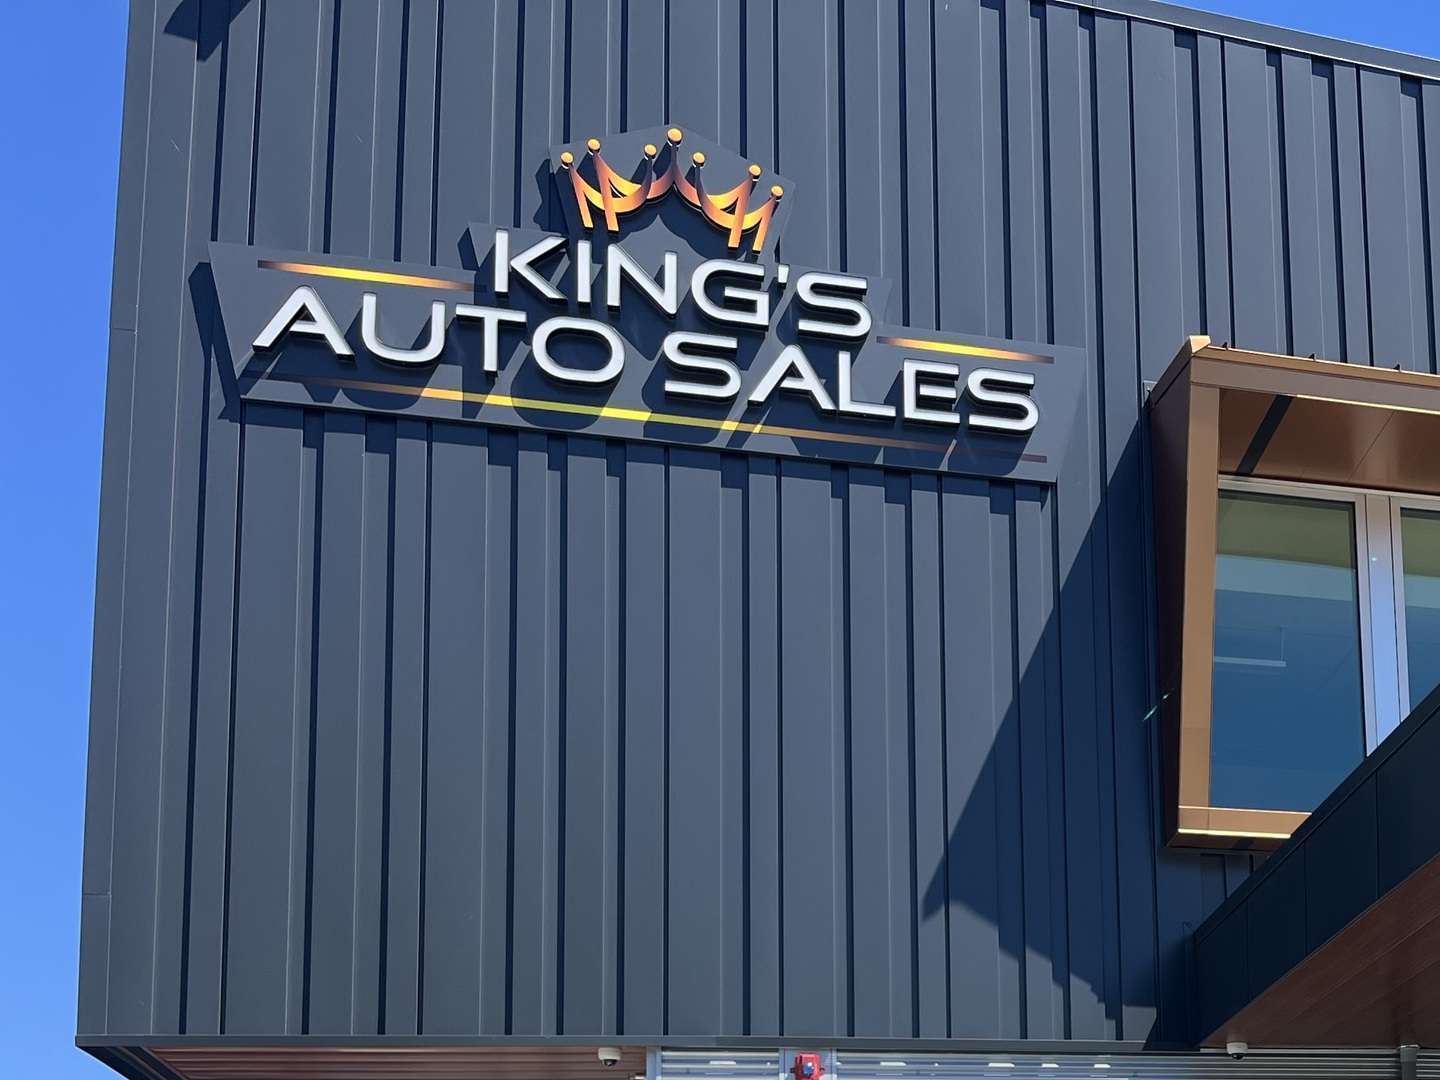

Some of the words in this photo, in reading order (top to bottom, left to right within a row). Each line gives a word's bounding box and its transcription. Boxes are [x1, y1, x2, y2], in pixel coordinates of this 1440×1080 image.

[493, 228, 873, 341] KING'S
[252, 284, 624, 385] AUTO
[664, 332, 1040, 435] SALES
